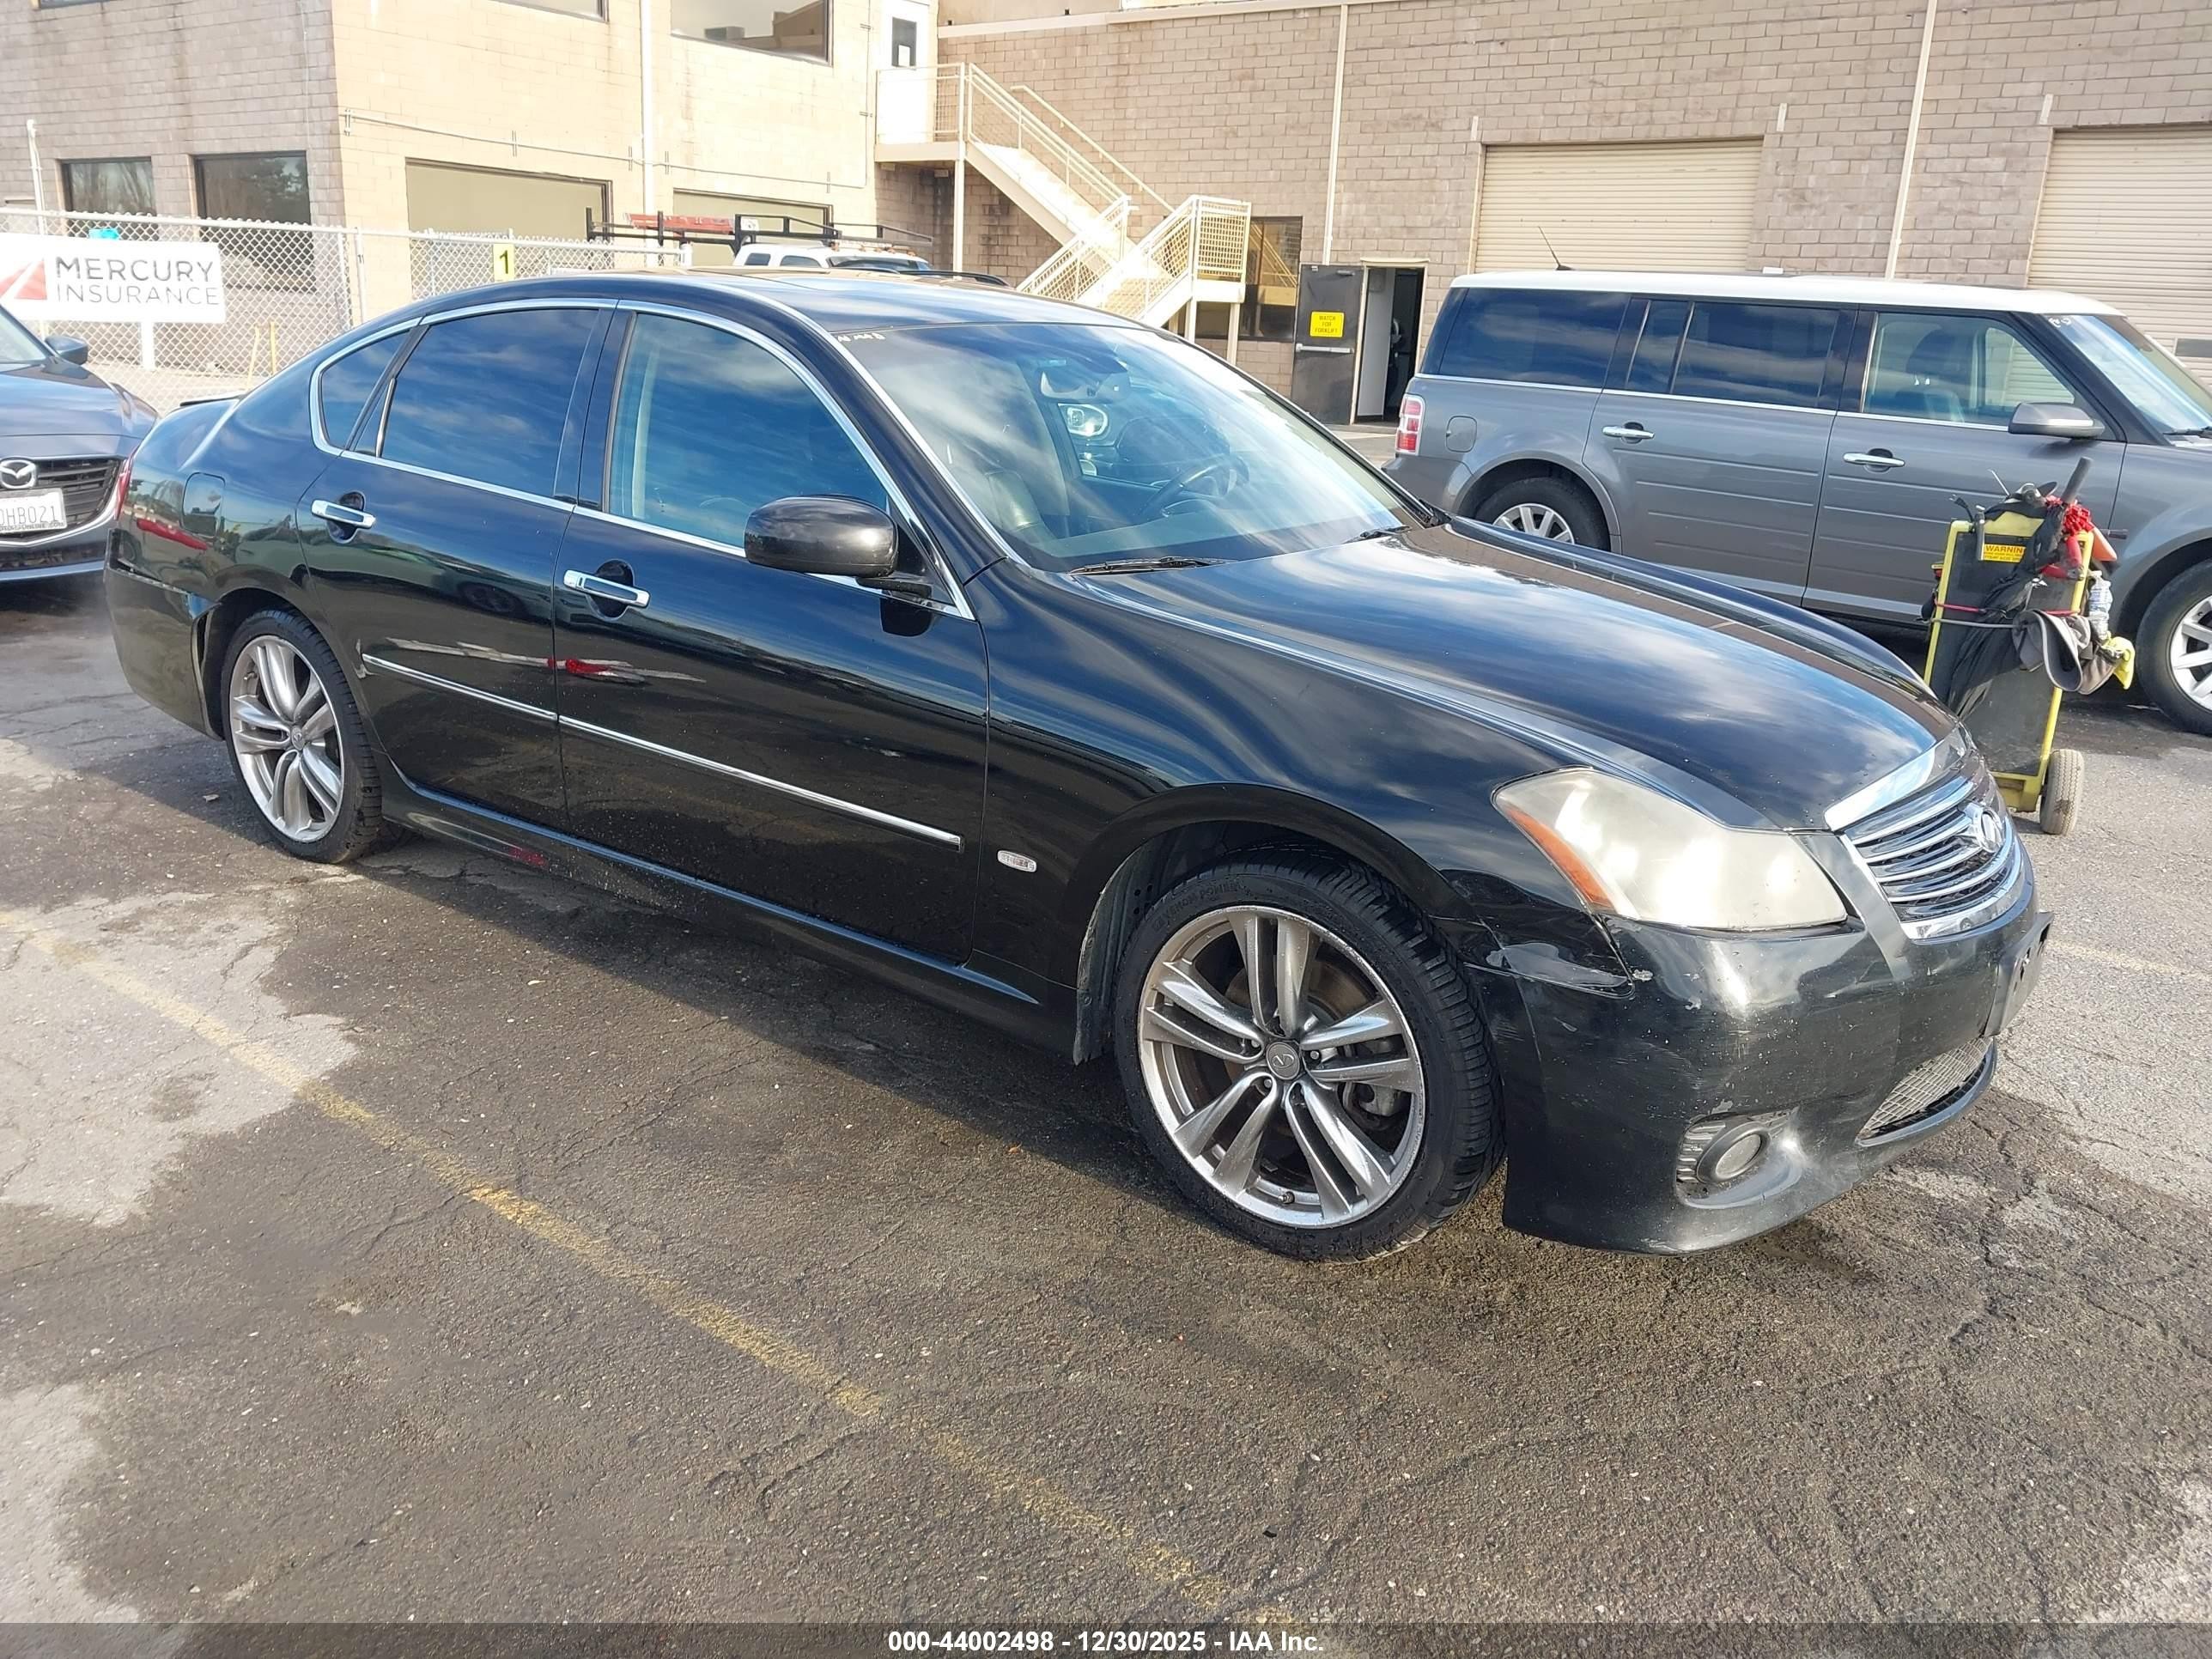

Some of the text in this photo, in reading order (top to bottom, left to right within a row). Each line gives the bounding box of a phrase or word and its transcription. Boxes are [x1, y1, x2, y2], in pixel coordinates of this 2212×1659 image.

[55, 257, 213, 282] MERCURY
[499, 250, 509, 274] 1
[57, 283, 219, 305] INSURANCE
